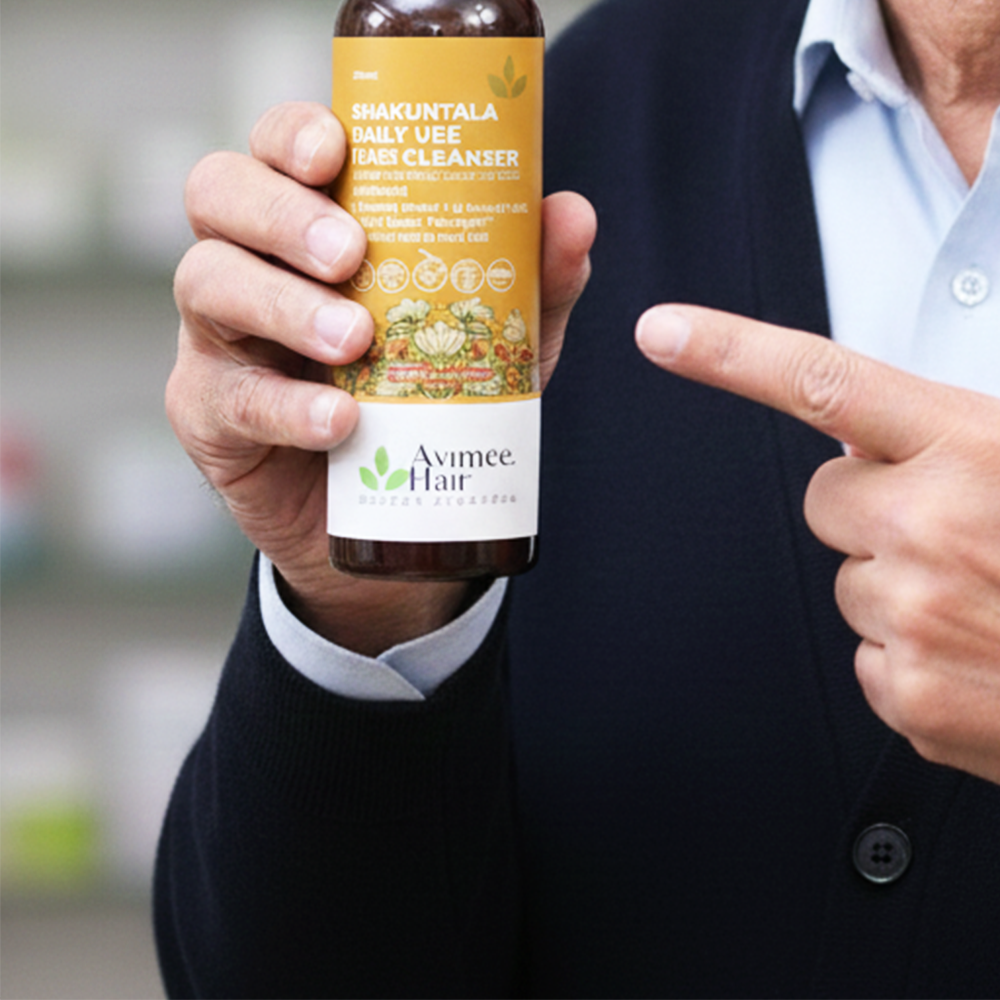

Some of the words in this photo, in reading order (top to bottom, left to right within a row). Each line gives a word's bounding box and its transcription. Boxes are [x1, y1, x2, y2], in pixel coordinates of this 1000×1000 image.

[351, 102, 499, 121] SHAKUNTALA
[402, 148, 519, 167] CLEANSER
[410, 466, 472, 491] Hair
